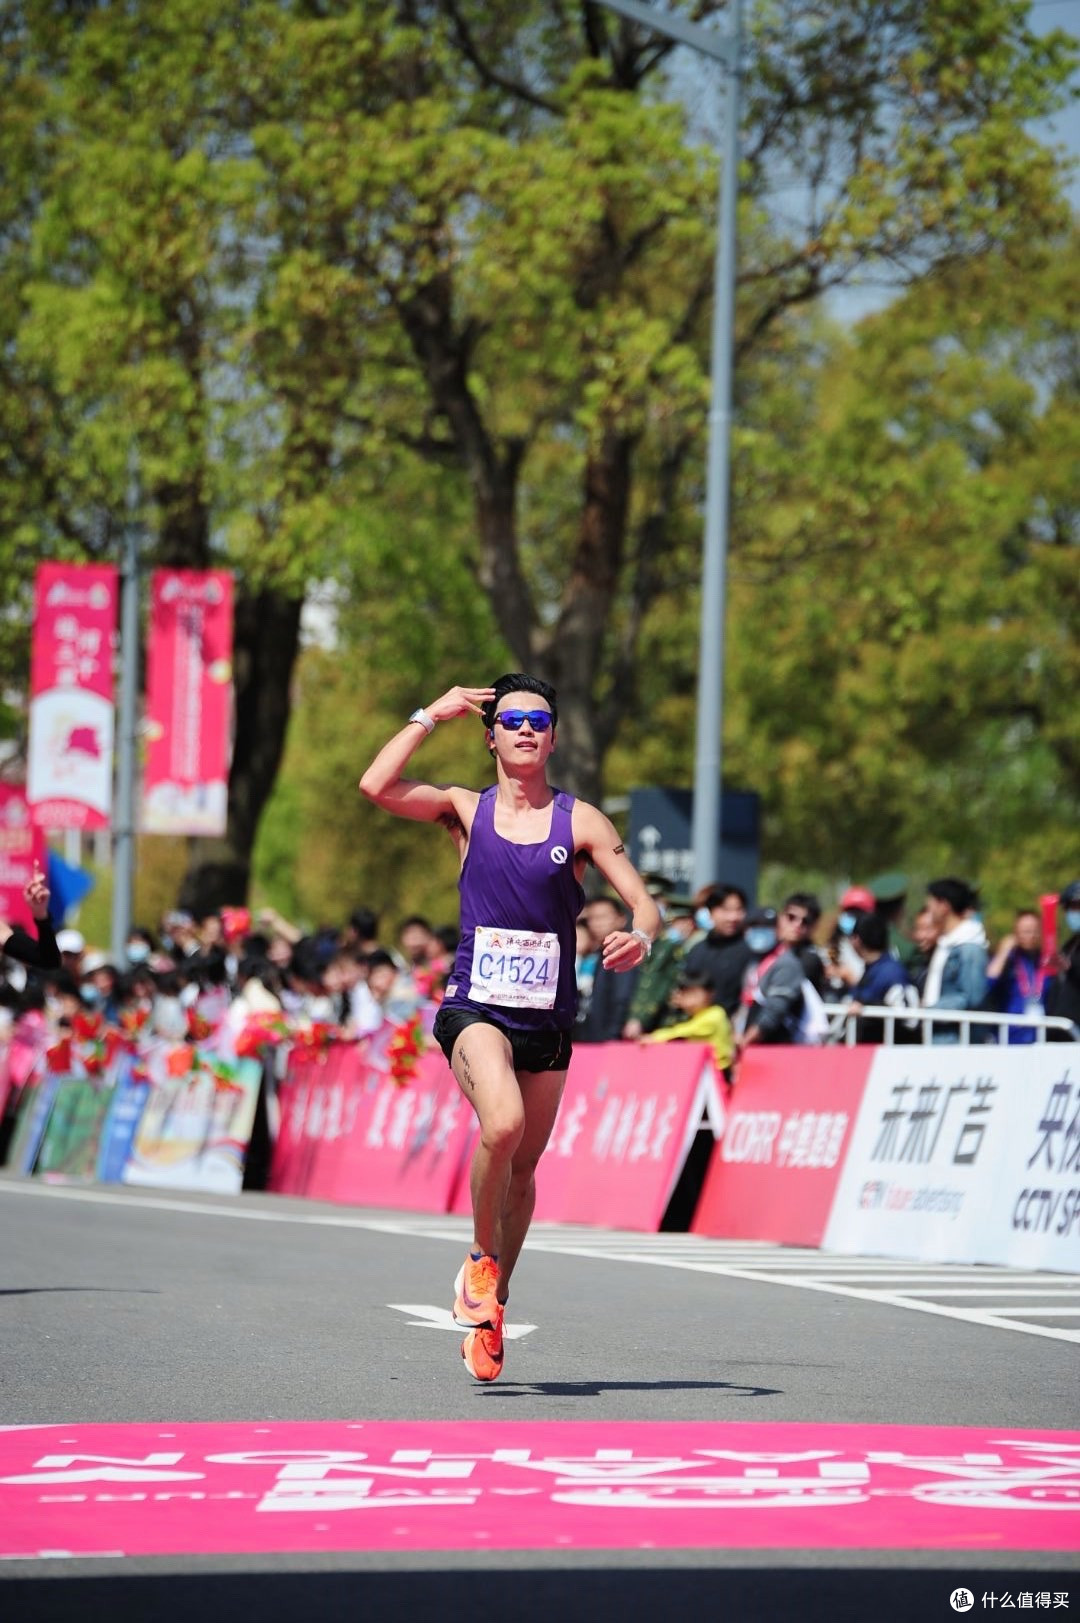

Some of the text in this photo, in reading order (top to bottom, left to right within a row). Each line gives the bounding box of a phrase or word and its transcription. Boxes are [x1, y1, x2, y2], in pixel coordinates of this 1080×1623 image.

[479, 953, 549, 986] C1524
[870, 1076, 998, 1165] 未来广告
[1012, 1188, 1062, 1232] CCTV
